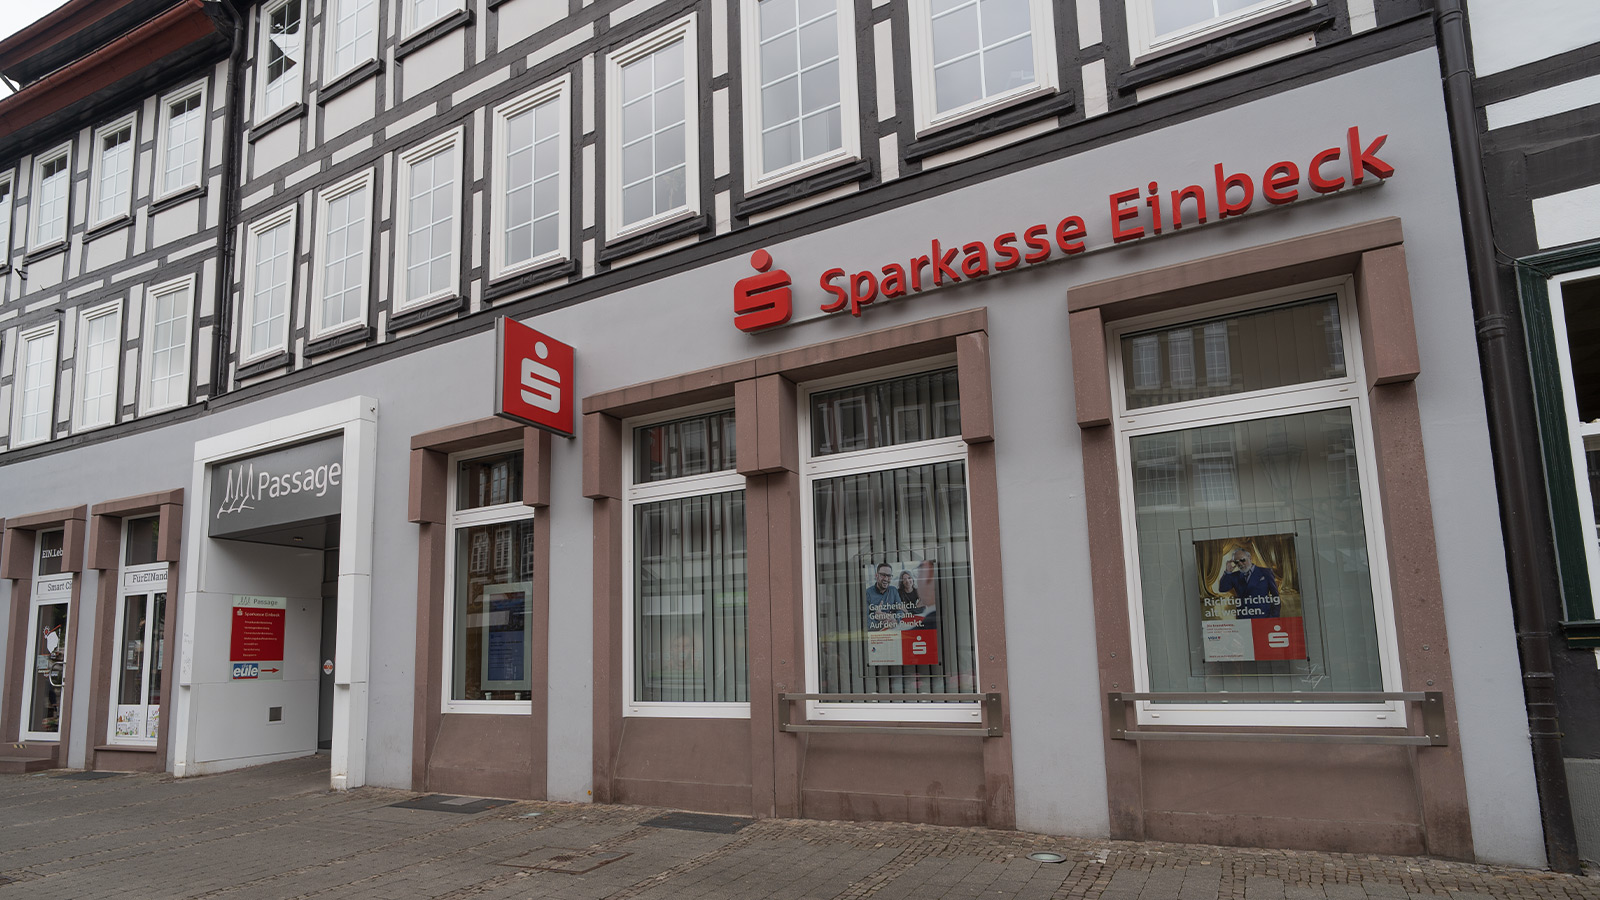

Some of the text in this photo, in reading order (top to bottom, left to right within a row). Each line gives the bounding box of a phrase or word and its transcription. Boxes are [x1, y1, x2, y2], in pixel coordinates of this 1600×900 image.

[819, 126, 1395, 317] Sparkasse Einbeck
[258, 462, 341, 500] Passage
[47, 583, 65, 592] Smart
[253, 598, 278, 606] Passage
[869, 602, 917, 611] Ganzheitlich.
[1204, 595, 1281, 607] Richtig richtig
[1205, 606, 1265, 618] alt werden.
[869, 620, 925, 629] Auf den Punkt.
[233, 664, 258, 676] eule
